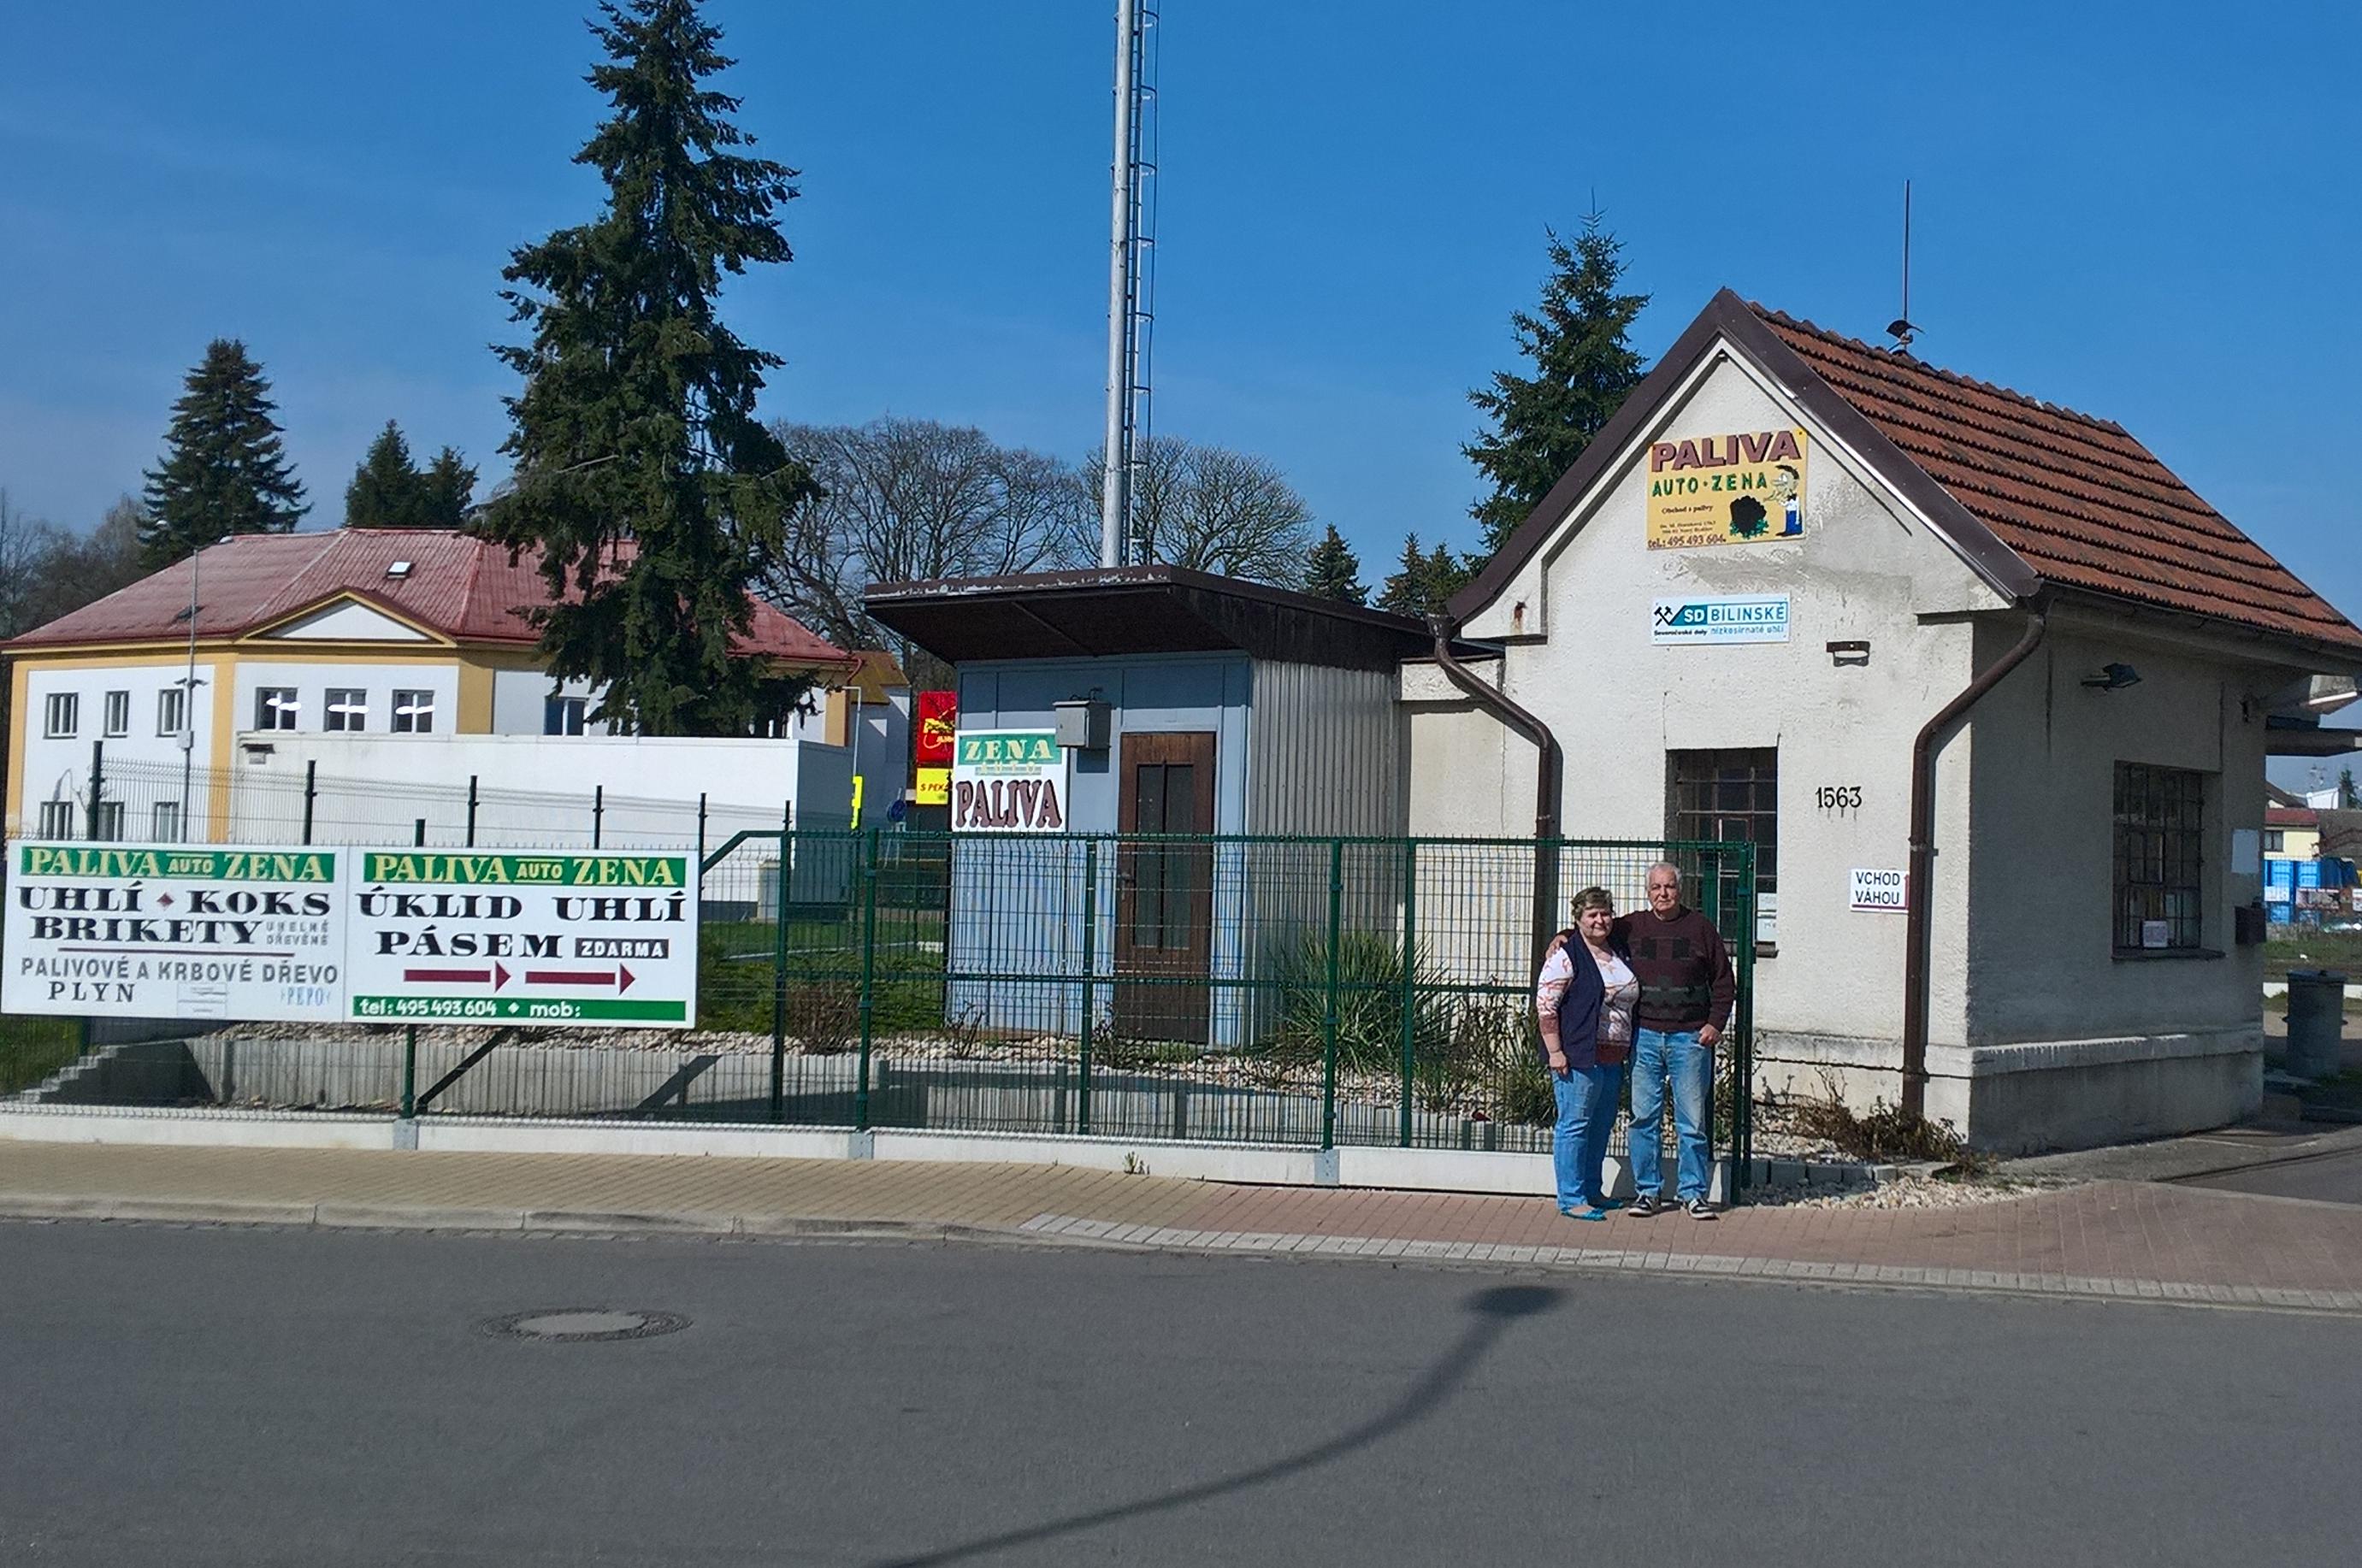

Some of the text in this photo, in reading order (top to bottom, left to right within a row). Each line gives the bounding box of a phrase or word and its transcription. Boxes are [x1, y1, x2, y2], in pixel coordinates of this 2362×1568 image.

[1650, 430, 1802, 472] PALIVA
[1652, 472, 1768, 498] AUTO ZENA
[1668, 535, 1685, 545] 495
[1686, 534, 1704, 545] 493
[1684, 609, 1705, 622] SD
[965, 739, 1054, 760] ZENA
[955, 780, 1062, 828] PALIVA
[1816, 786, 1862, 809] 1563
[29, 848, 327, 881] PALIVA AUTO ZENA
[372, 855, 677, 886] PALIVA AUTO ZENA
[1856, 871, 1900, 886] VCHOD
[16, 881, 331, 916] UHLÍ KOKS
[356, 885, 686, 922] ÚKLID UHLÍ
[1856, 887, 1899, 905] VÁHOU
[29, 916, 263, 945] BRIKETY
[375, 924, 564, 958] PÁSEM
[581, 940, 664, 958] ZDARMA
[21, 955, 338, 984] PALIVOVÉ A KRBOVÉ DŘEVO
[48, 981, 135, 1002] PLYN
[359, 999, 582, 1019] tel: 495 493 604 mob:
